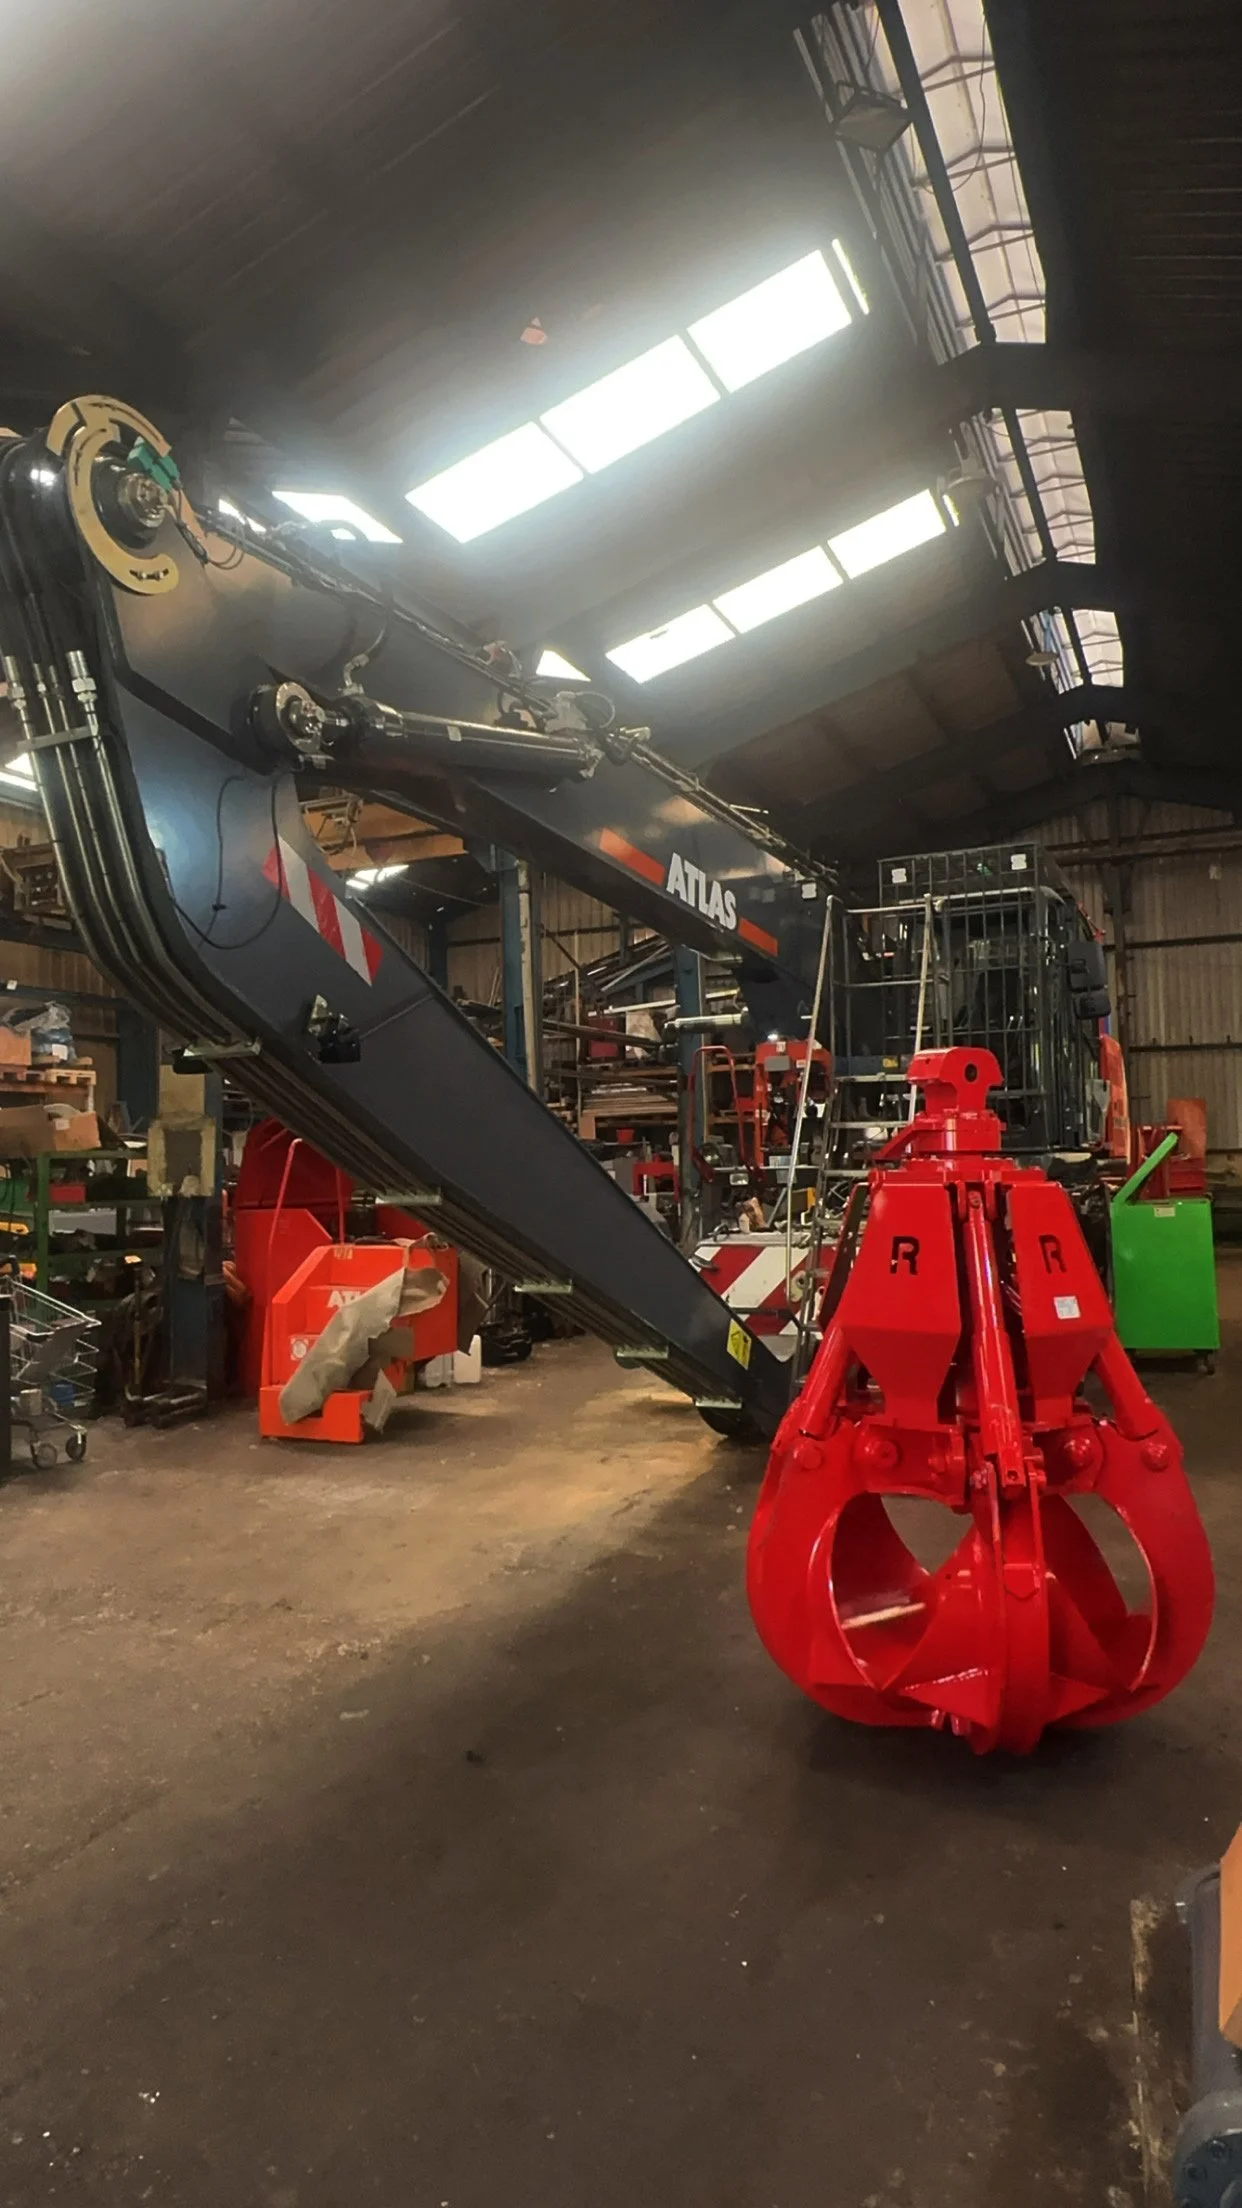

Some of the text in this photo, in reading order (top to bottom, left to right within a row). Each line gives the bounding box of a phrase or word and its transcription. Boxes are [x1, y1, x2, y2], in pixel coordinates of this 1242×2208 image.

[666, 852, 737, 930] ATLAS
[889, 1236, 920, 1275] R
[1038, 1234, 1067, 1273] R
